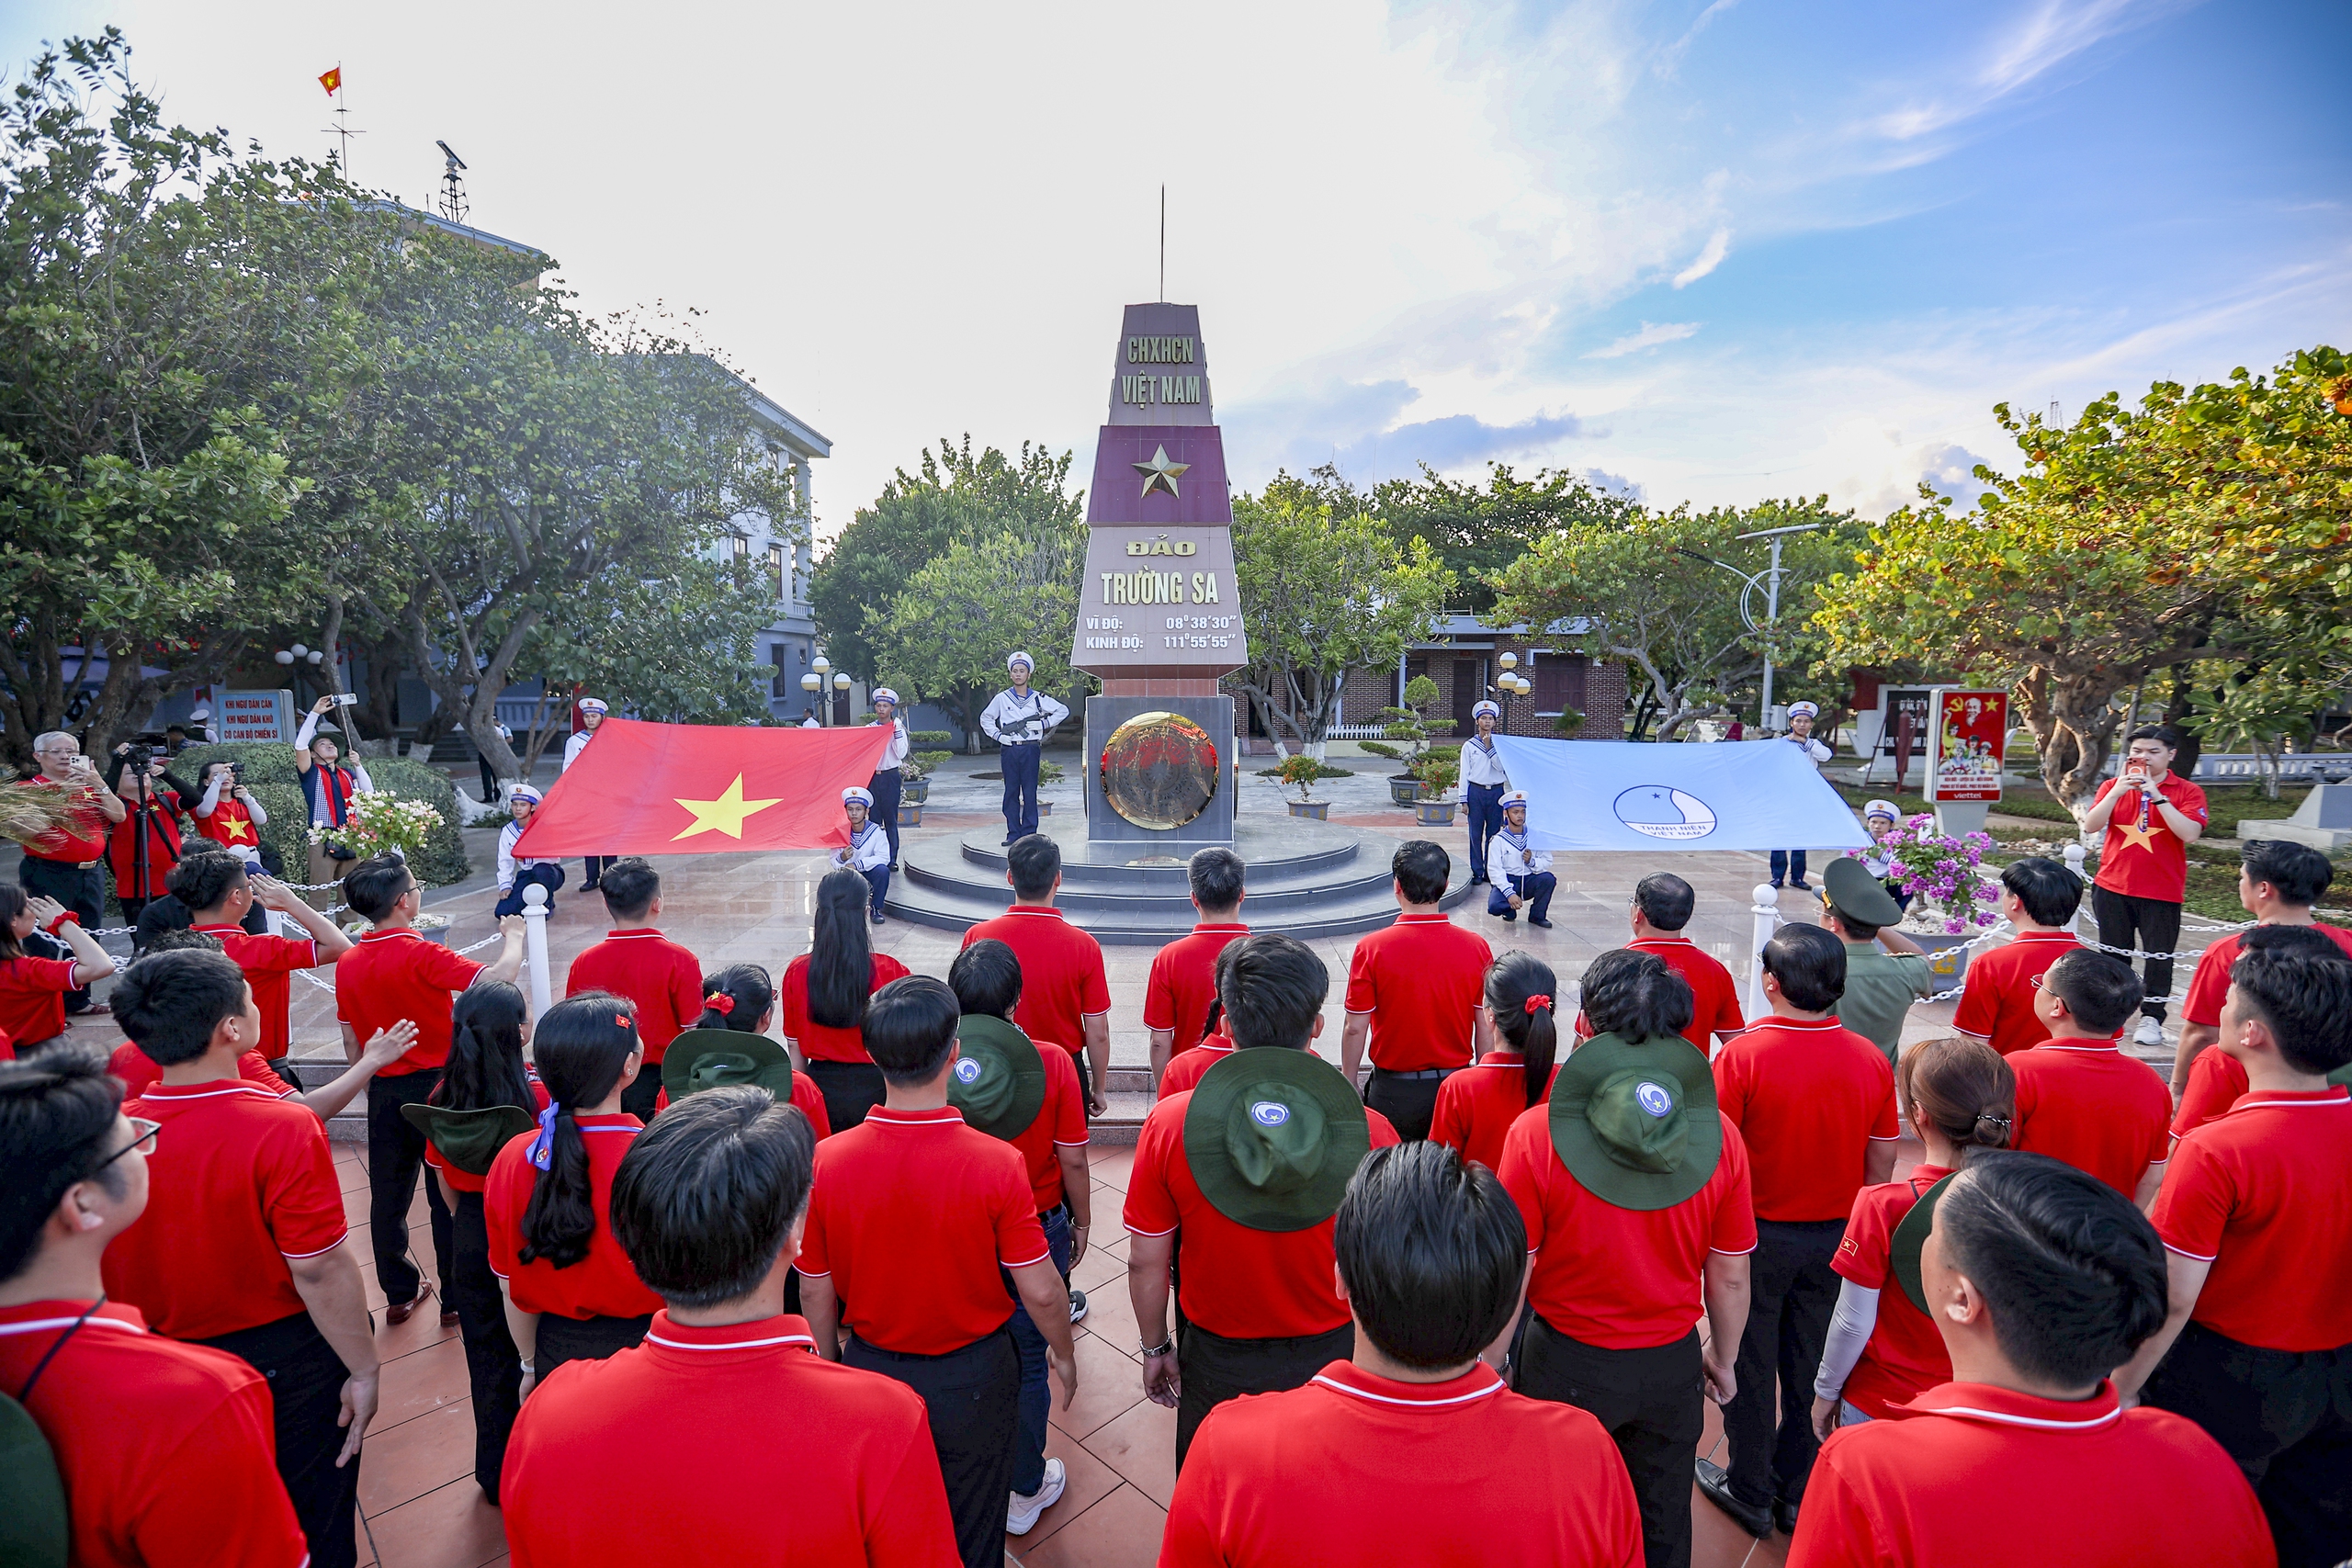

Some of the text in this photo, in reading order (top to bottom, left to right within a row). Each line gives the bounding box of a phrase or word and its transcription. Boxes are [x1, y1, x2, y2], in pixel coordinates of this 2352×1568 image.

[1127, 337, 1194, 364] CHXHCN
[1121, 370, 1201, 410] VIỆT NAM
[1126, 533, 1196, 557] ĐẢO
[1101, 564, 1219, 604] TRƯỜNG SA
[1085, 637, 1118, 649] KINH
[1121, 634, 1144, 653] ĐỘ:
